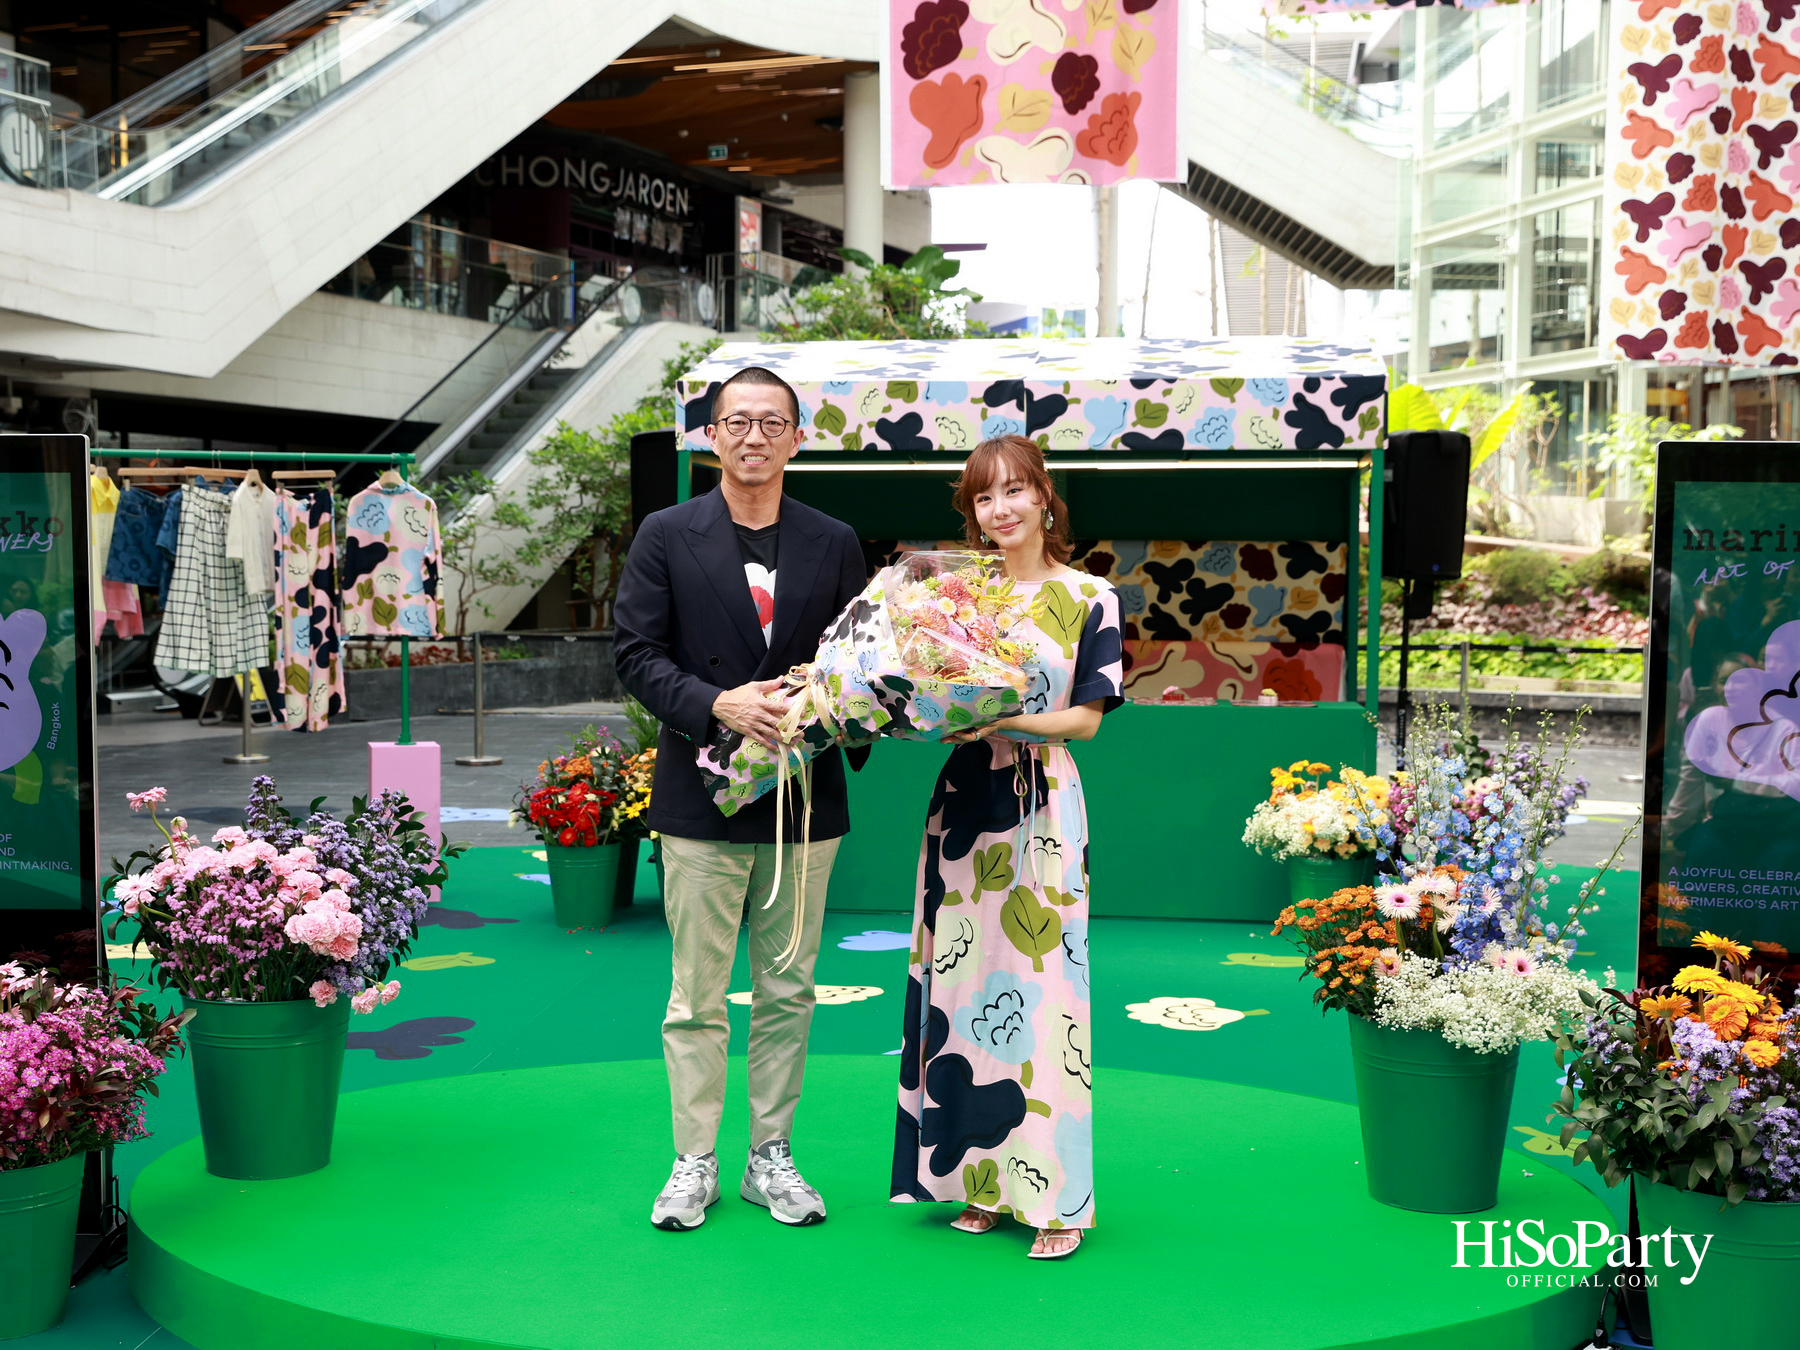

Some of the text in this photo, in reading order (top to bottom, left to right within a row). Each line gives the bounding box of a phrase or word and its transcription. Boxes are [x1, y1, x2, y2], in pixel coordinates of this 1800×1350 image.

[1683, 523, 1800, 552] mari
[1693, 559, 1795, 587] ART OF
[46, 702, 62, 750] Bangkok
[1668, 866, 1679, 876] A
[1681, 867, 1736, 879] JOYFUL
[1668, 881, 1739, 895] FLOWERS,
[1770, 900, 1799, 911] ART
